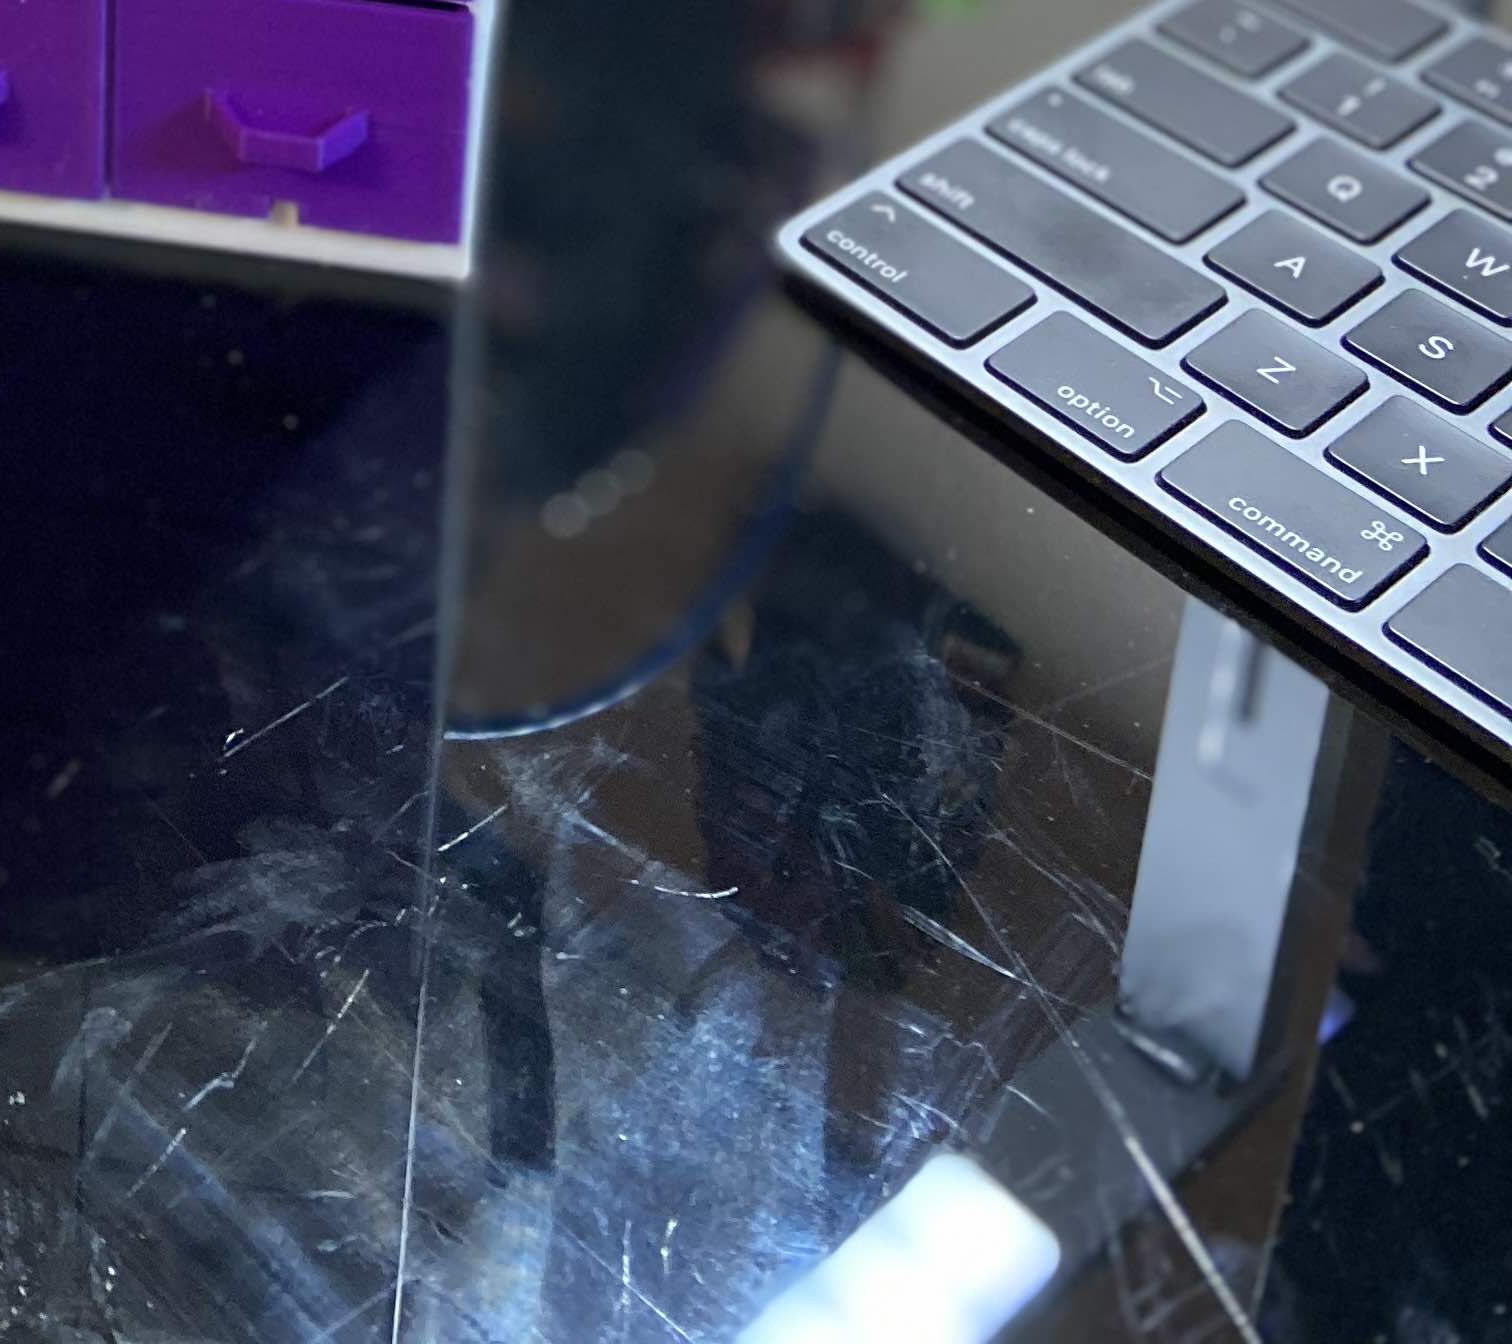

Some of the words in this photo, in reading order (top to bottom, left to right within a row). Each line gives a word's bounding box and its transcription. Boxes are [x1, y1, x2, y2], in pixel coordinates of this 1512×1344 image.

[920, 171, 976, 210] shift
[1327, 175, 1363, 202] Q
[1464, 166, 1499, 190] 2
[827, 229, 909, 284] control
[1274, 255, 1307, 280] A
[1464, 248, 1511, 278] W
[1418, 335, 1455, 360] S
[1255, 356, 1297, 385] Z
[1056, 384, 1136, 440] option
[1400, 445, 1447, 476] X
[1227, 496, 1364, 585] command
